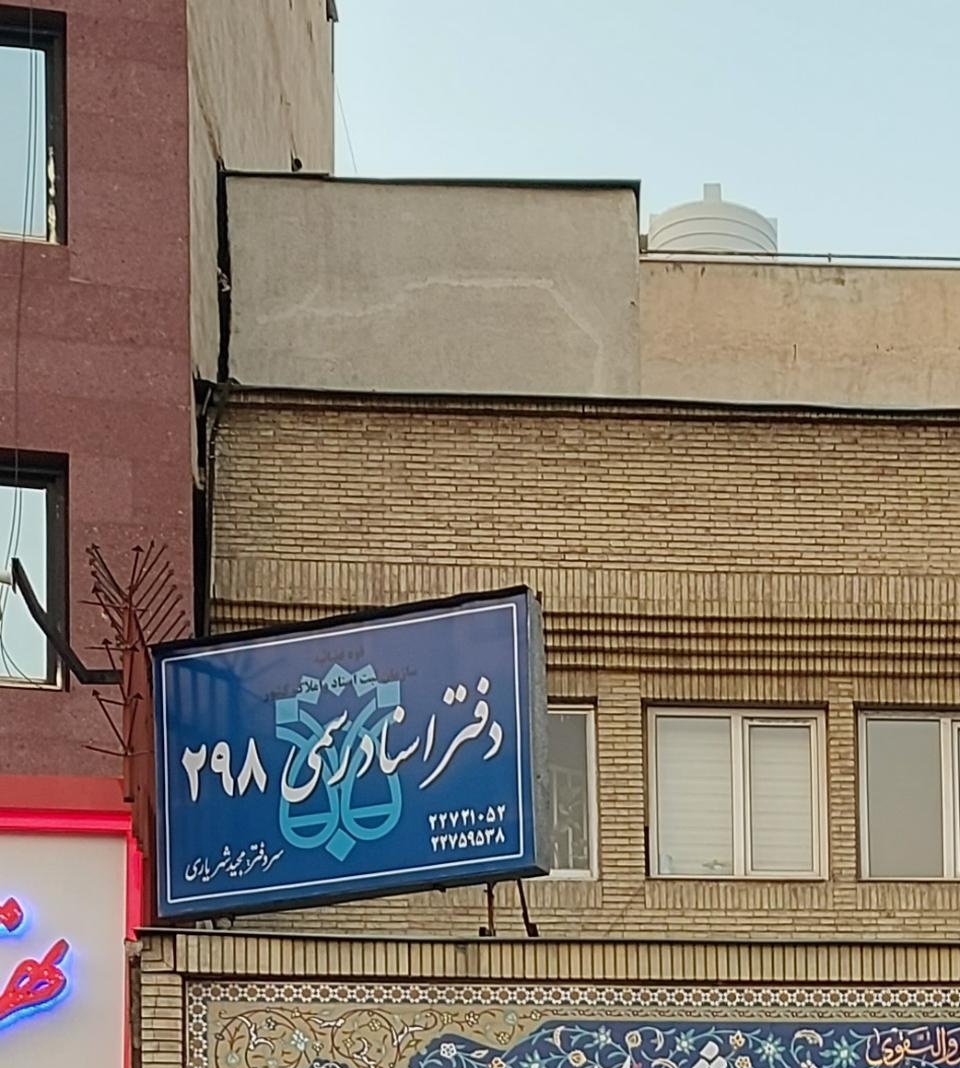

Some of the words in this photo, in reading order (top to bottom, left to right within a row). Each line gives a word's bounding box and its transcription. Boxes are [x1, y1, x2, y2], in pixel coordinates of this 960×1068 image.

[181, 736, 267, 803] ۲۹۸
[280, 708, 353, 804] رسمی
[356, 704, 436, 780] اسناد
[419, 677, 503, 789] دفتر
